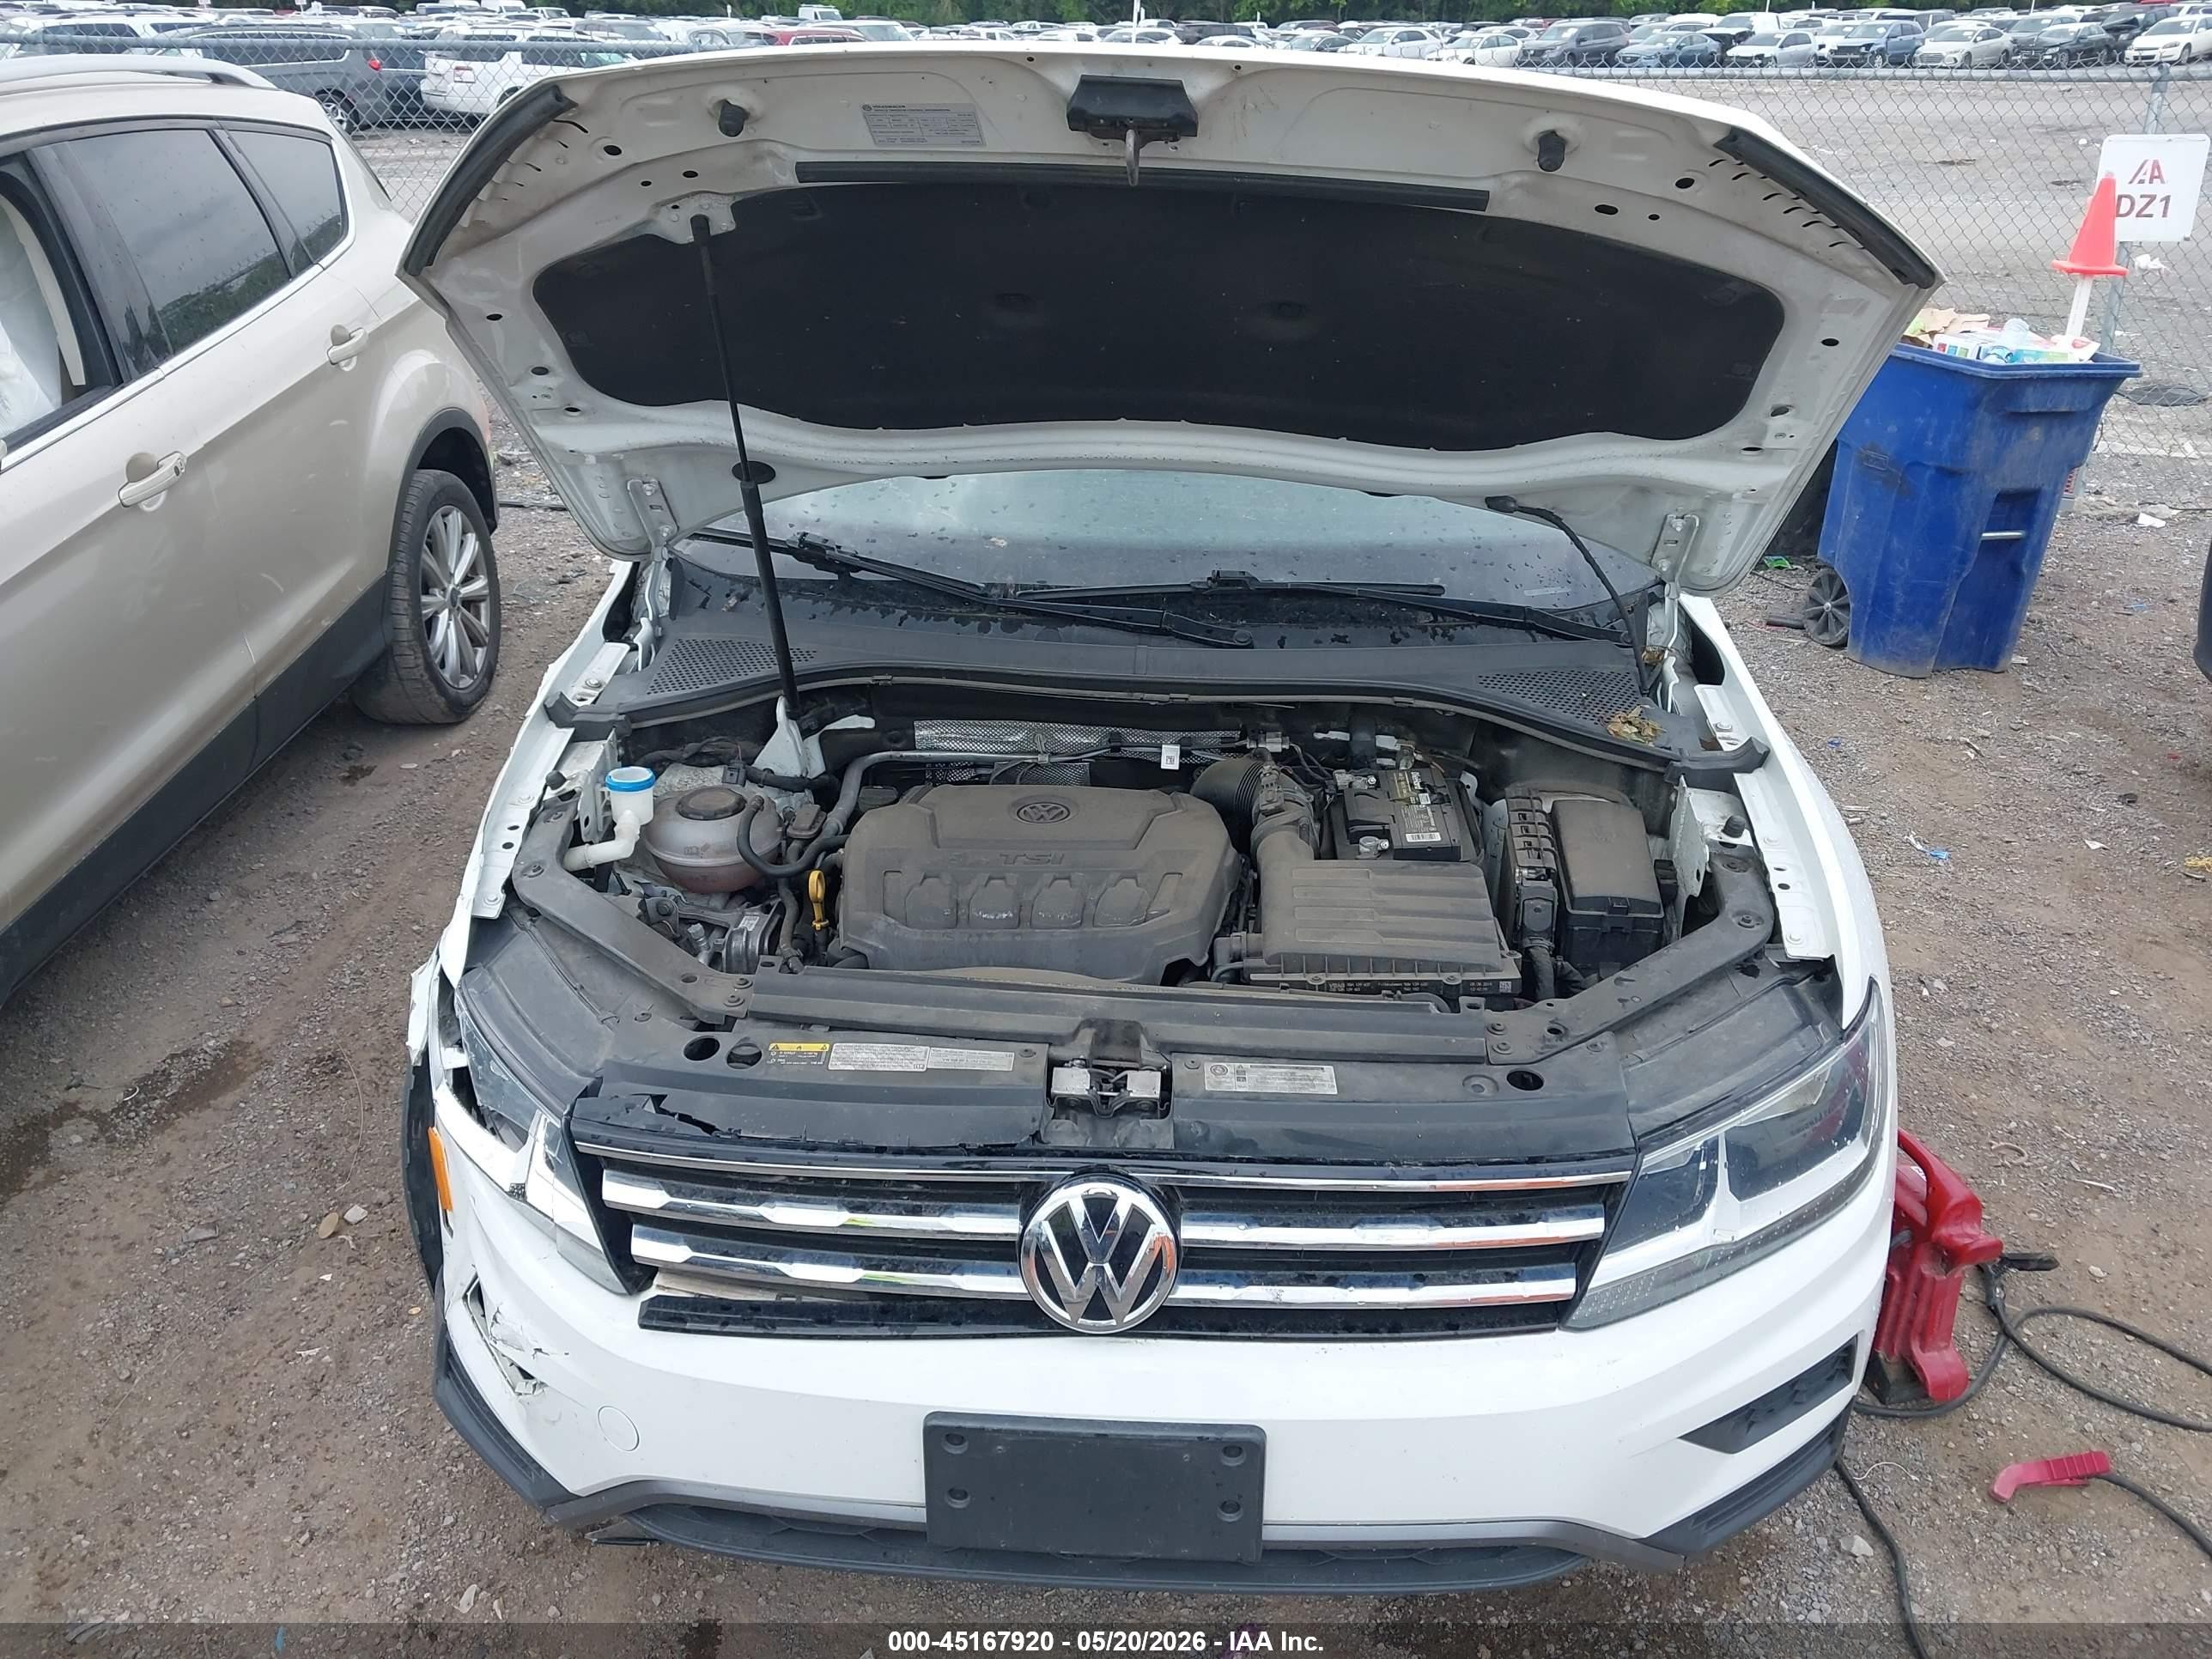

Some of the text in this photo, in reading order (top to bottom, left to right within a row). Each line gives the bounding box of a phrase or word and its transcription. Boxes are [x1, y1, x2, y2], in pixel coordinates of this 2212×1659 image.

[2116, 193, 2171, 217] DZ1
[999, 853, 1065, 866] TSI
[1020, 1180, 1178, 1334] VW
